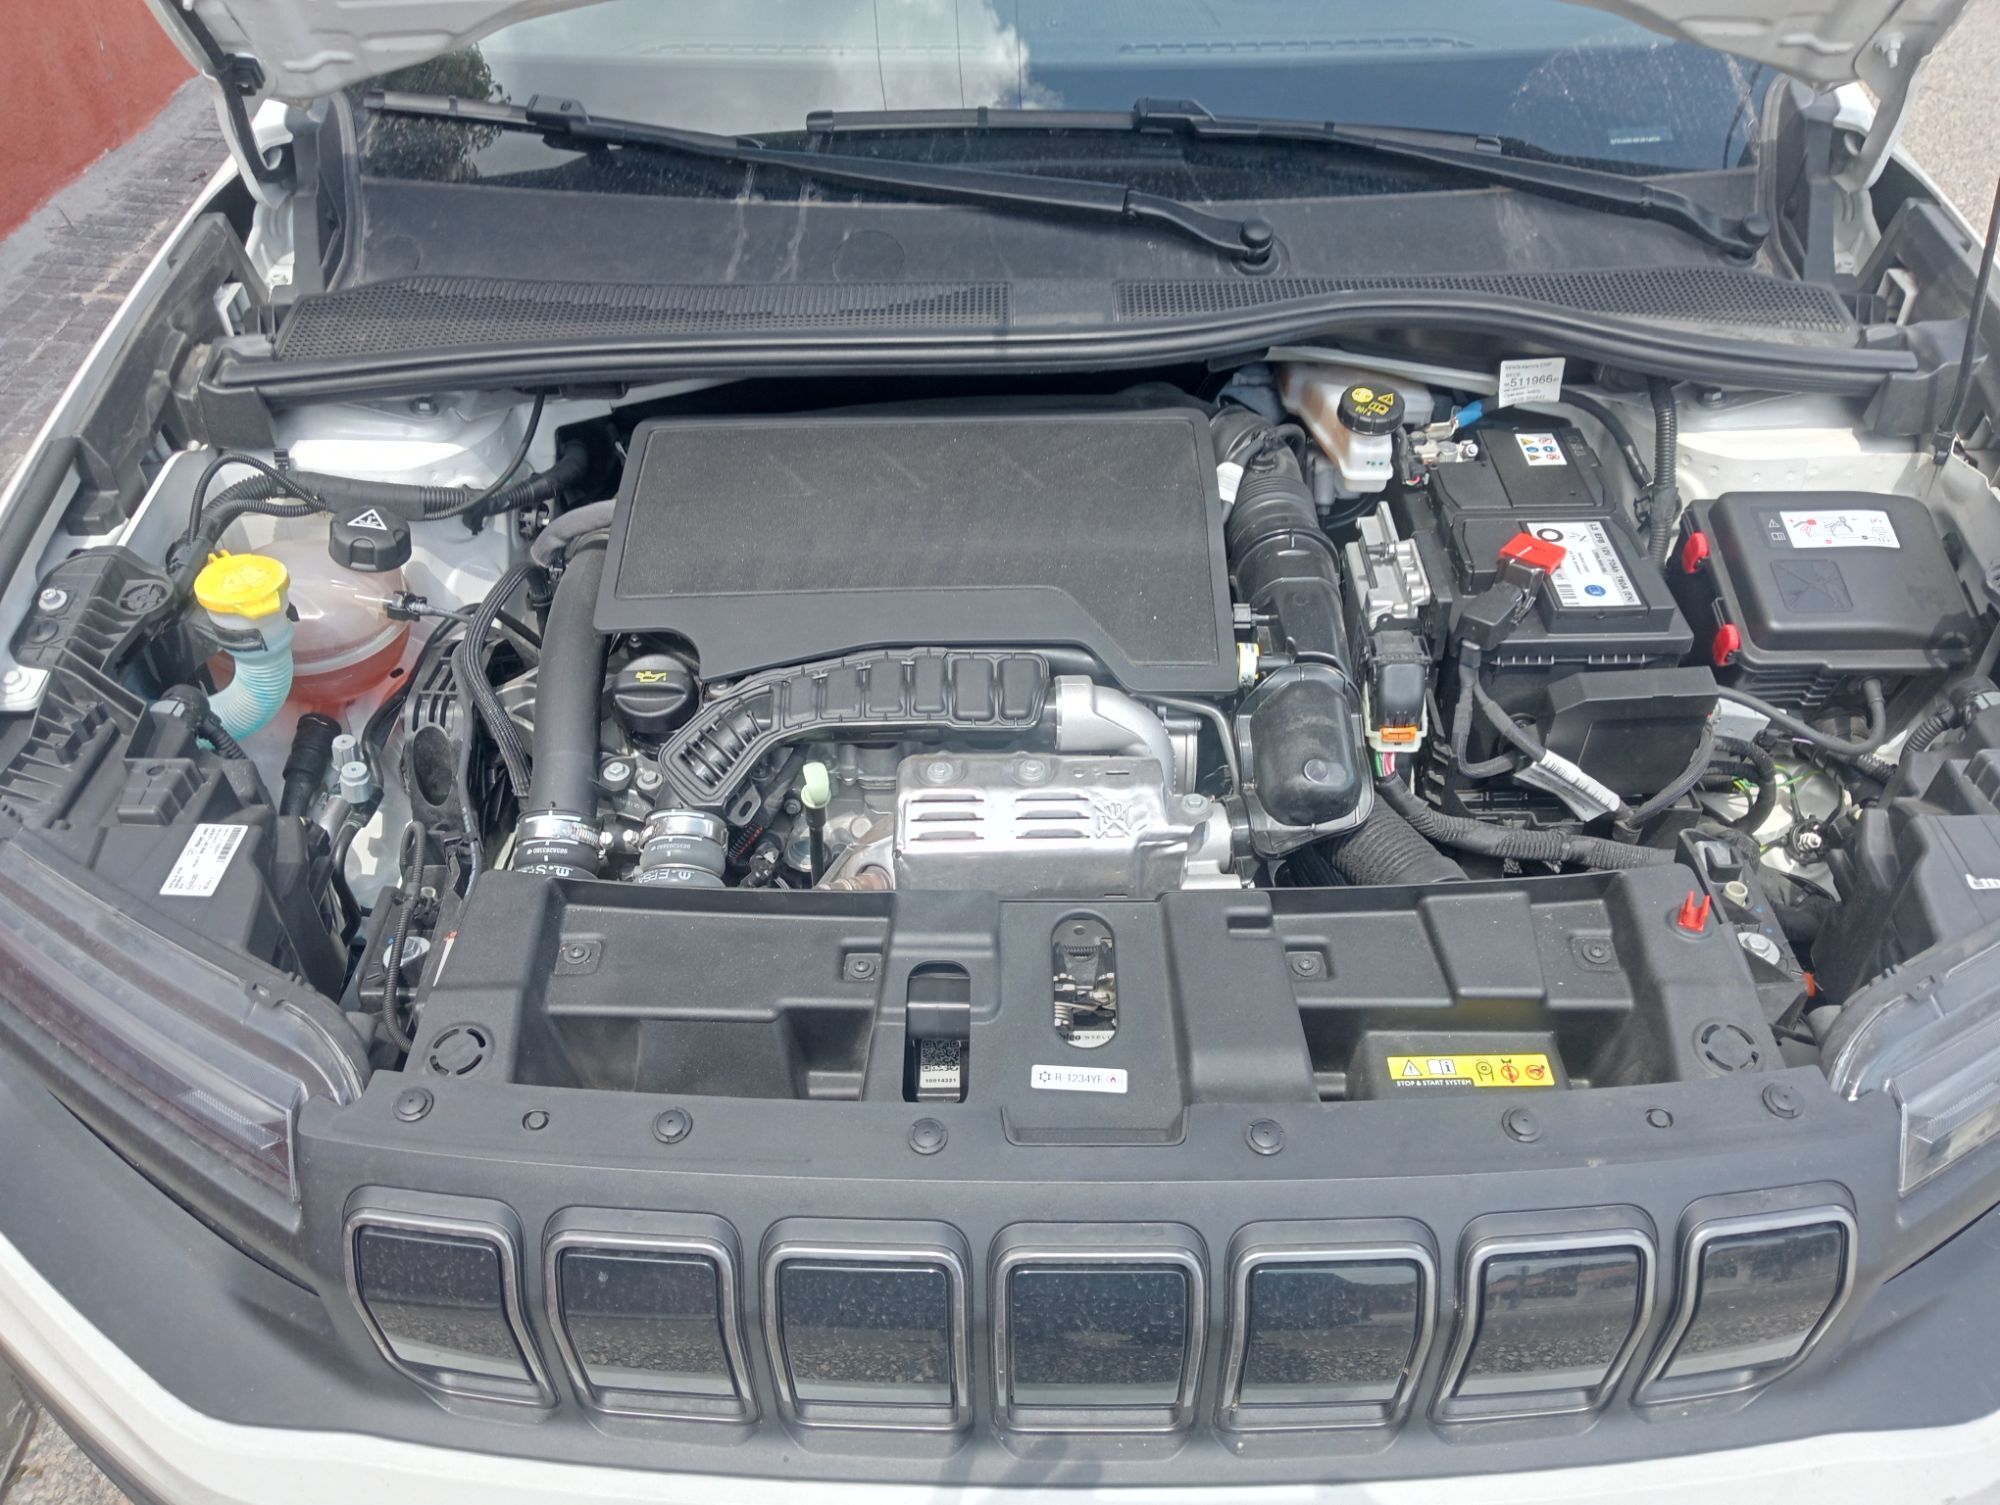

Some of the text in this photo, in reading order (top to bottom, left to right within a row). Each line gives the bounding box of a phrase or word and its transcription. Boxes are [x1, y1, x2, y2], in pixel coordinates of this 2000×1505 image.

[1510, 374, 1553, 387] 511966
[1397, 1079, 1415, 1087] STOP
[1423, 1079, 1444, 1087] START
[1445, 1079, 1472, 1087] SYSTEM
